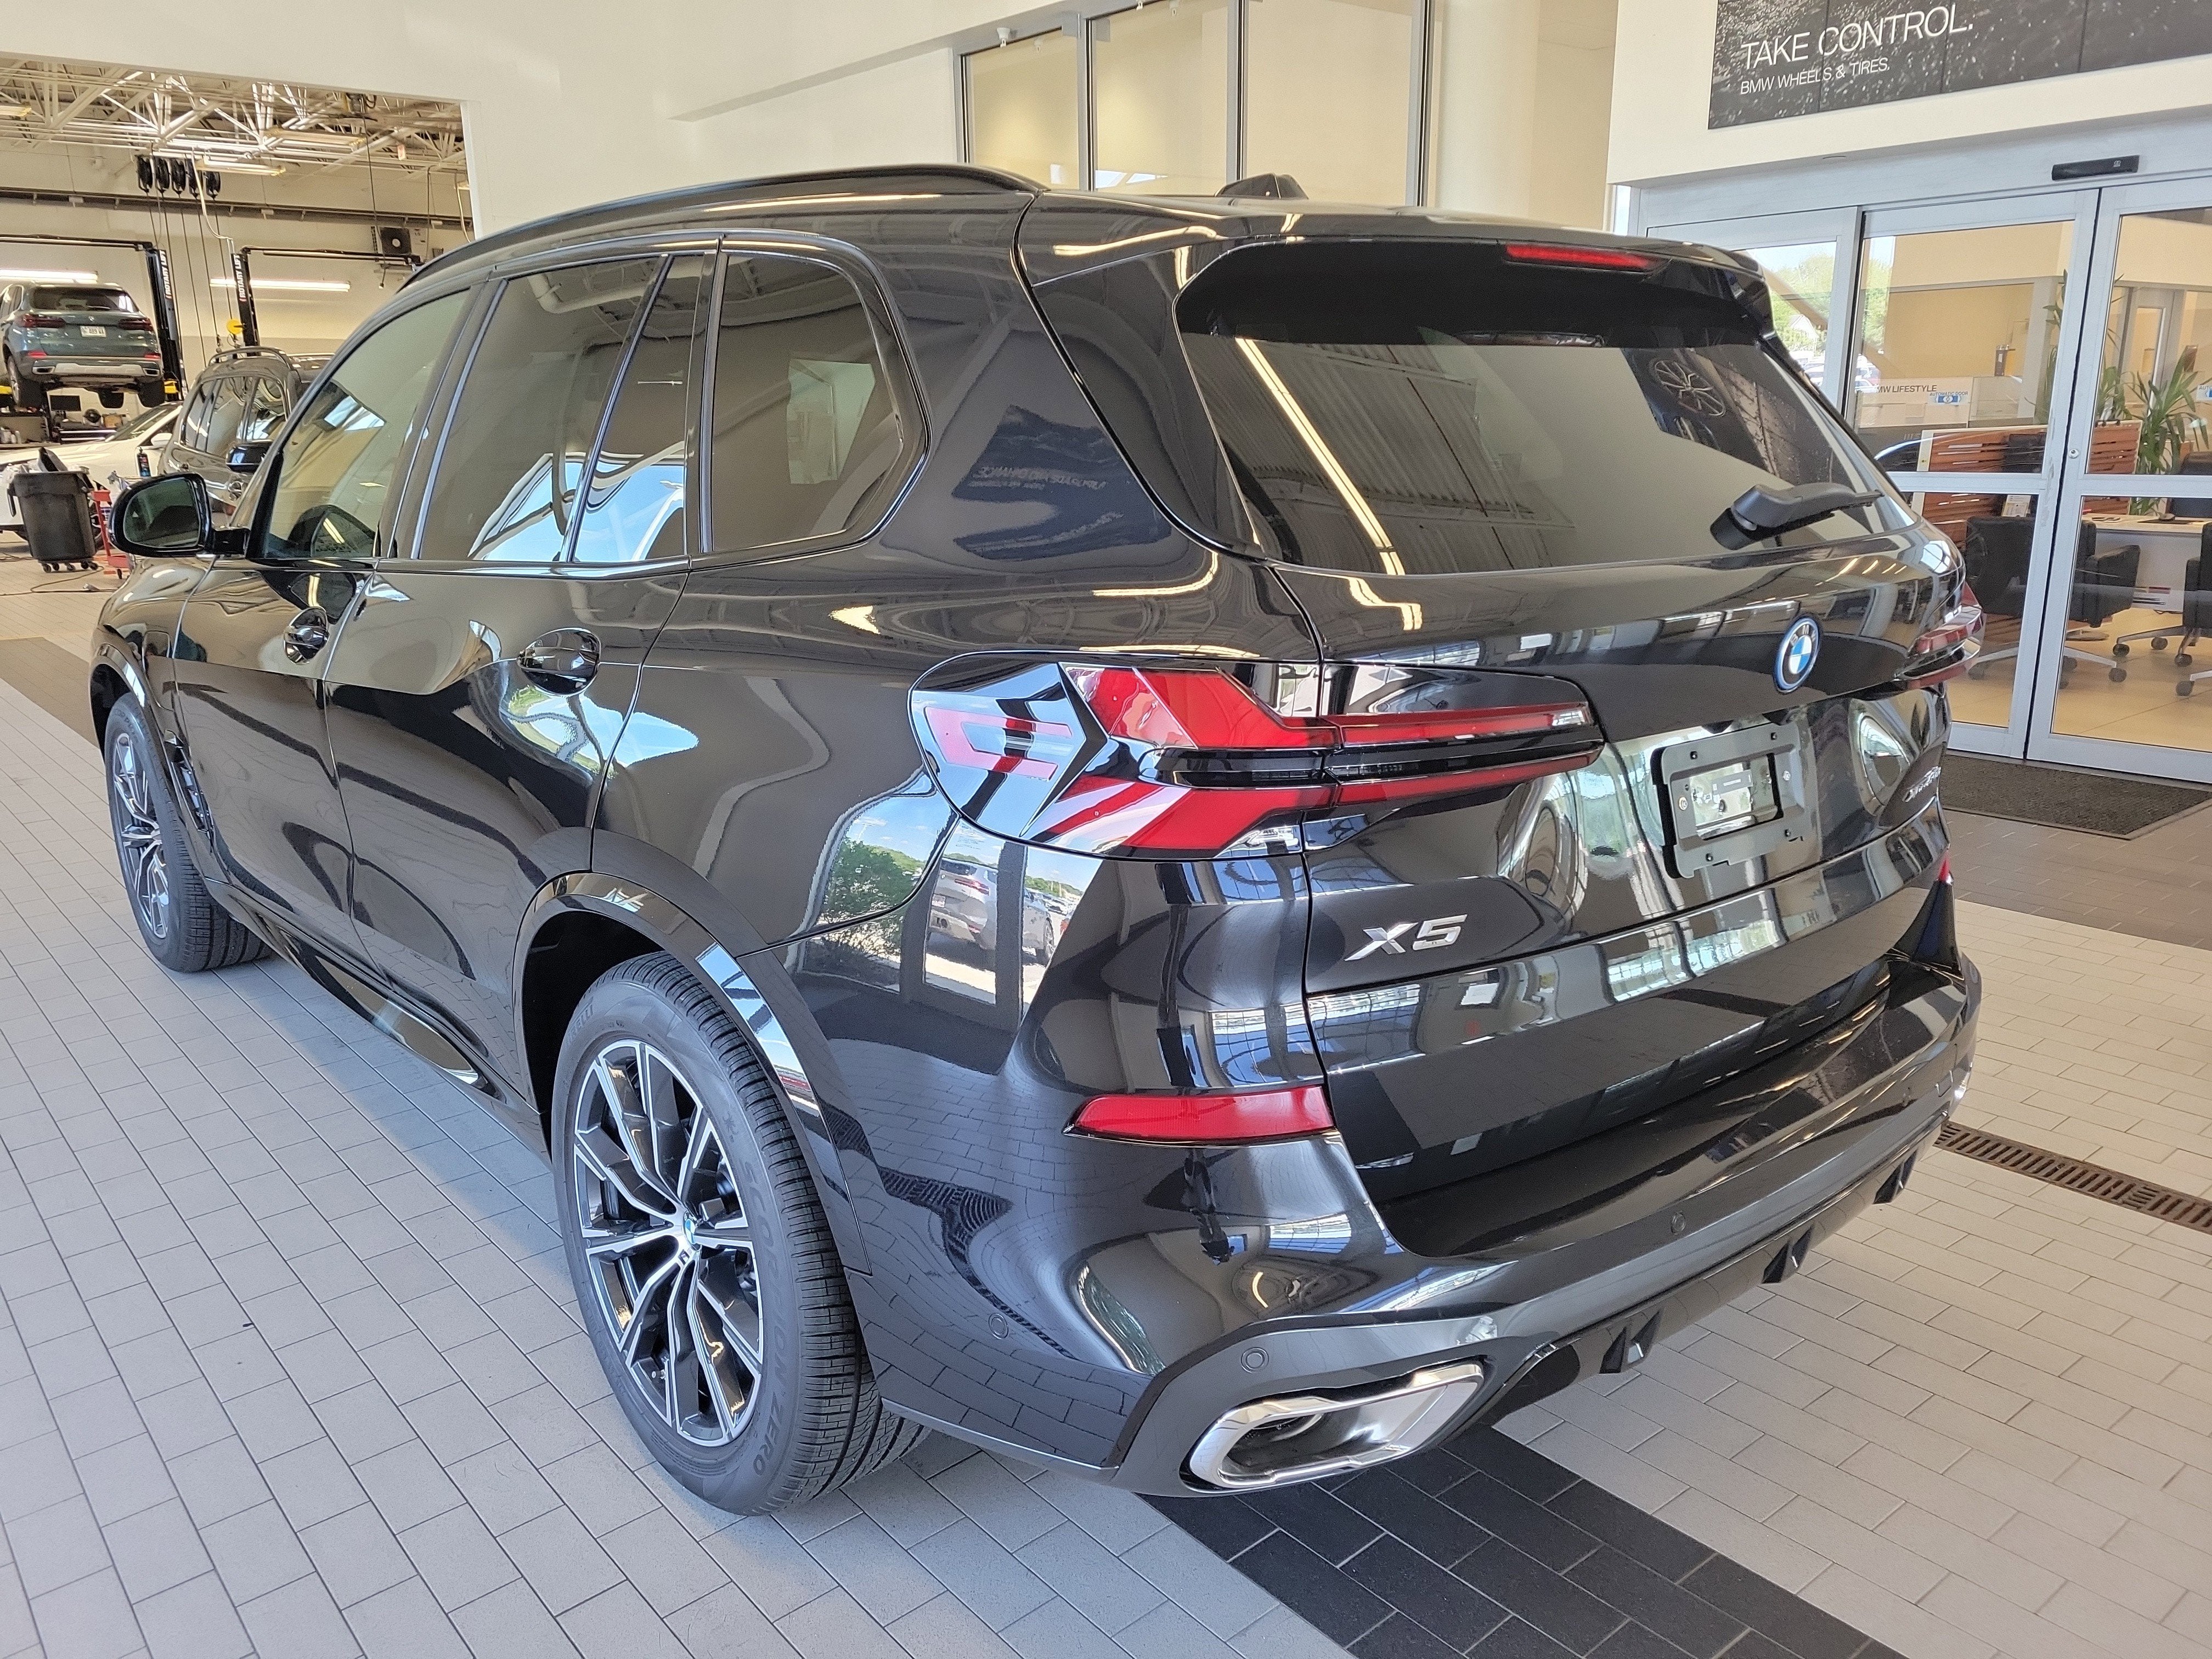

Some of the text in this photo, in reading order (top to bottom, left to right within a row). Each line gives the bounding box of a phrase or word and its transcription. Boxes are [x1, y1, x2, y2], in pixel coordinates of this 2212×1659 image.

[1741, 4, 1973, 70] TAKE CONTROL.
[1740, 57, 1890, 94] BMW WHEELS & TIRES.
[159, 250, 172, 295] ROTARY LIFT
[233, 253, 246, 297] ROTARY LIFT
[1892, 385, 1938, 393] LIFESTYLE
[1344, 915, 1468, 961] X5
